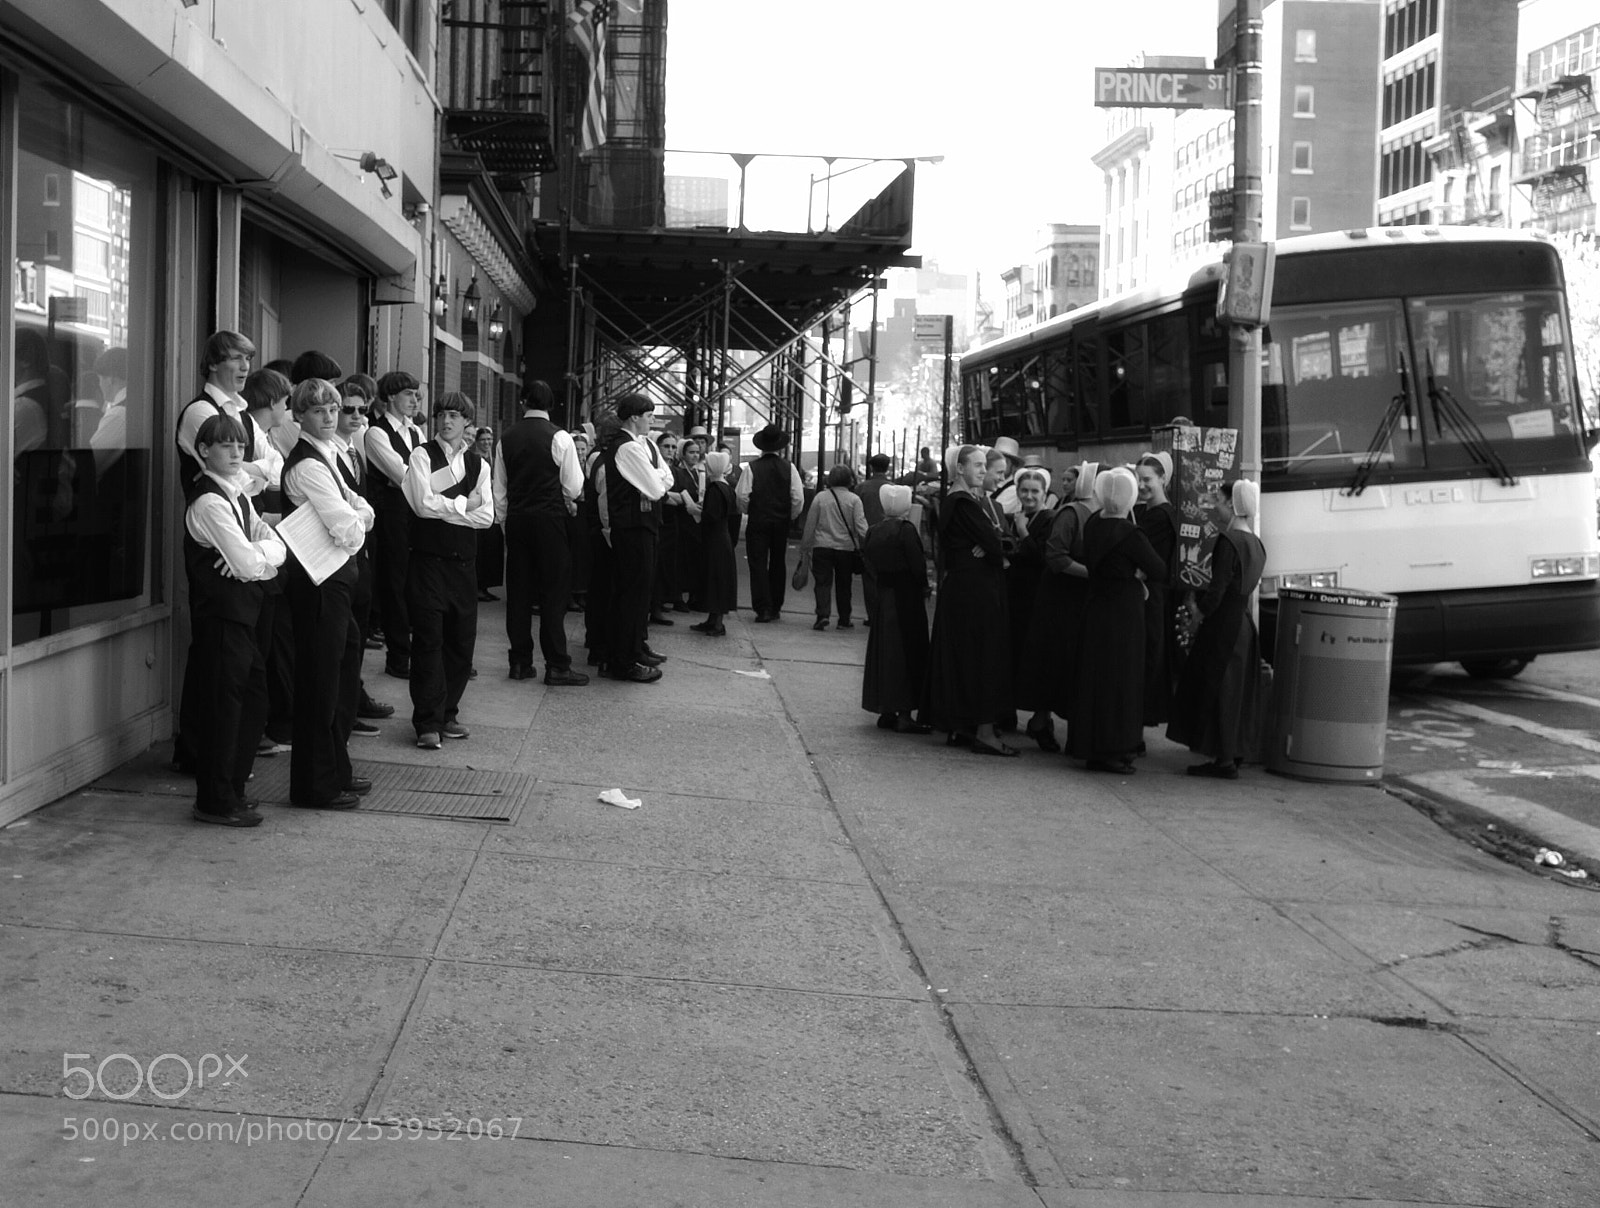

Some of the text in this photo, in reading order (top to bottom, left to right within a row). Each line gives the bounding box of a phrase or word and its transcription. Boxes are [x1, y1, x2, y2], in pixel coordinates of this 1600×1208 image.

[1099, 71, 1226, 104] PRINCE ST
[1320, 594, 1344, 604] Don't
[1347, 597, 1368, 607] litter
